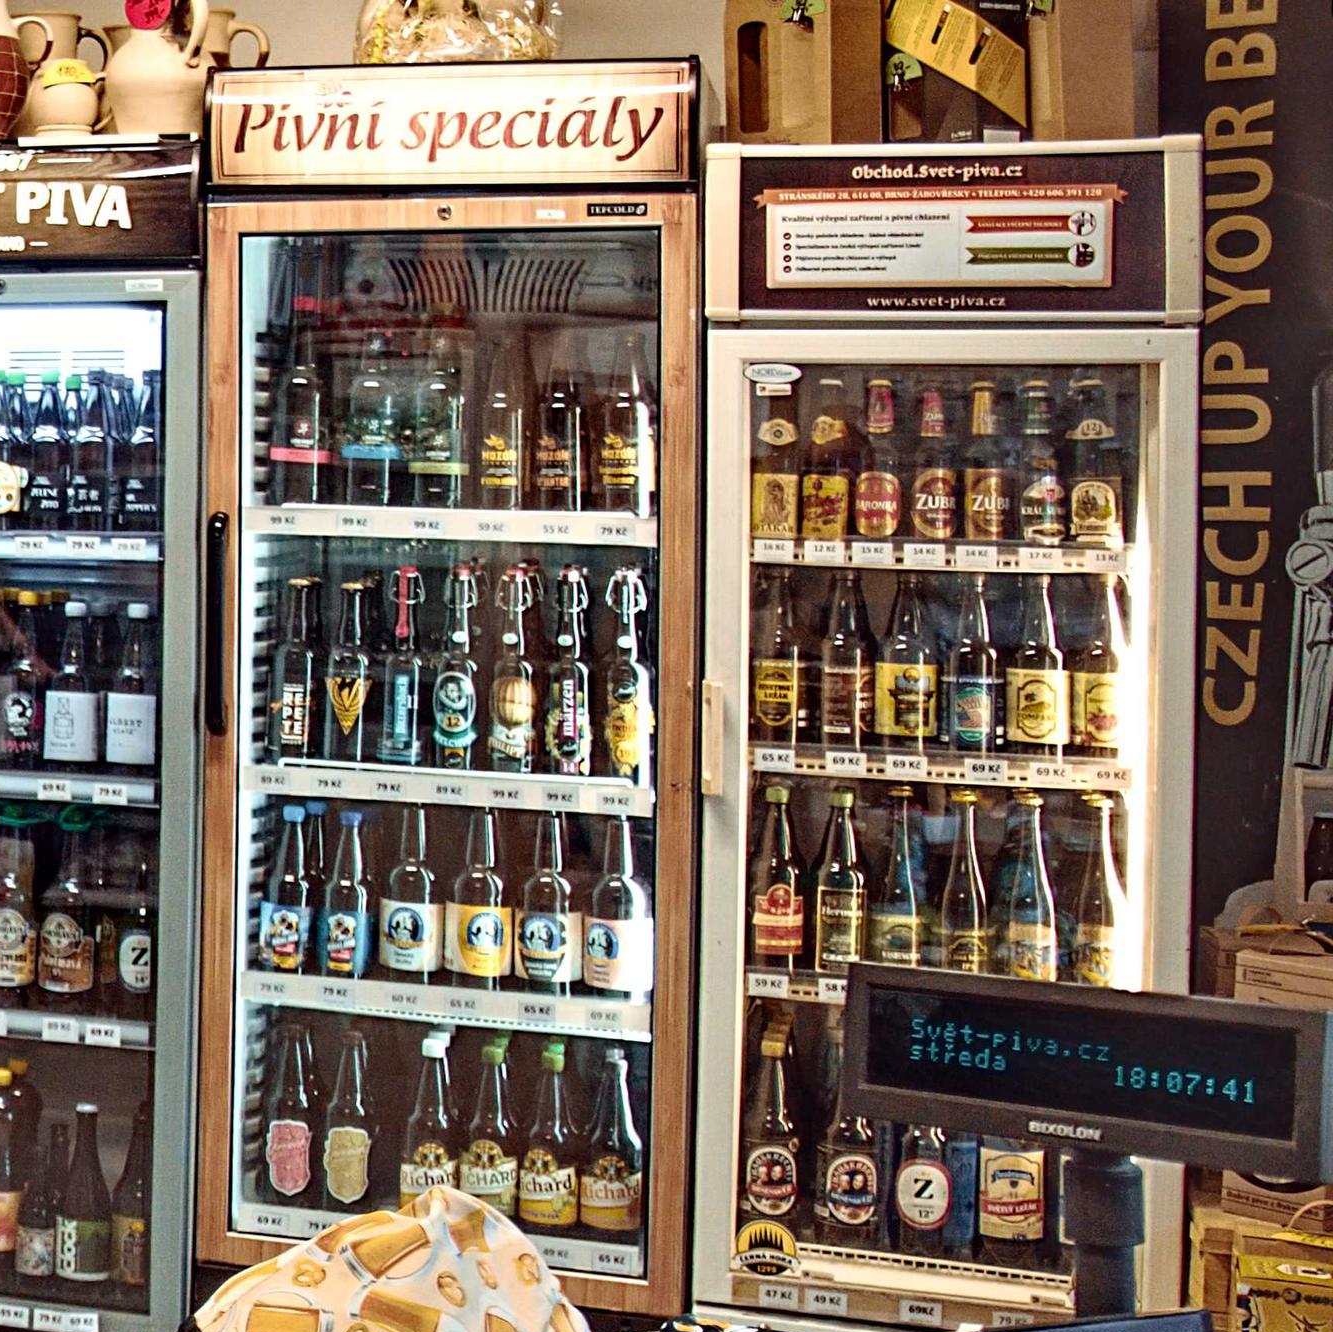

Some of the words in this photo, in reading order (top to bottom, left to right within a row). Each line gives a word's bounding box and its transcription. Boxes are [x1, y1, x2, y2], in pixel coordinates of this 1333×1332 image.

[234, 101, 385, 154] Pivní
[400, 95, 663, 163] speciály
[778, 191, 836, 201] STRÁNSKÉHO
[852, 191, 868, 200] 616
[978, 190, 1021, 199] TELEFON:
[1022, 189, 1044, 198] +420
[1045, 189, 1063, 198] 606
[1064, 189, 1082, 198] 391
[852, 163, 1023, 182] Obchod.Svet-piva.cz
[16, 181, 132, 231] PIVA
[1204, 100, 1275, 324] YOUR
[867, 294, 1006, 309] www.svet-piva.cz
[1203, 340, 1273, 445] UP
[1203, 471, 1273, 726] CZECH
[909, 1044, 1007, 1072] středa
[1113, 1065, 1256, 1105] 18:07:41
[1028, 1121, 1102, 1141] BIXOLON
